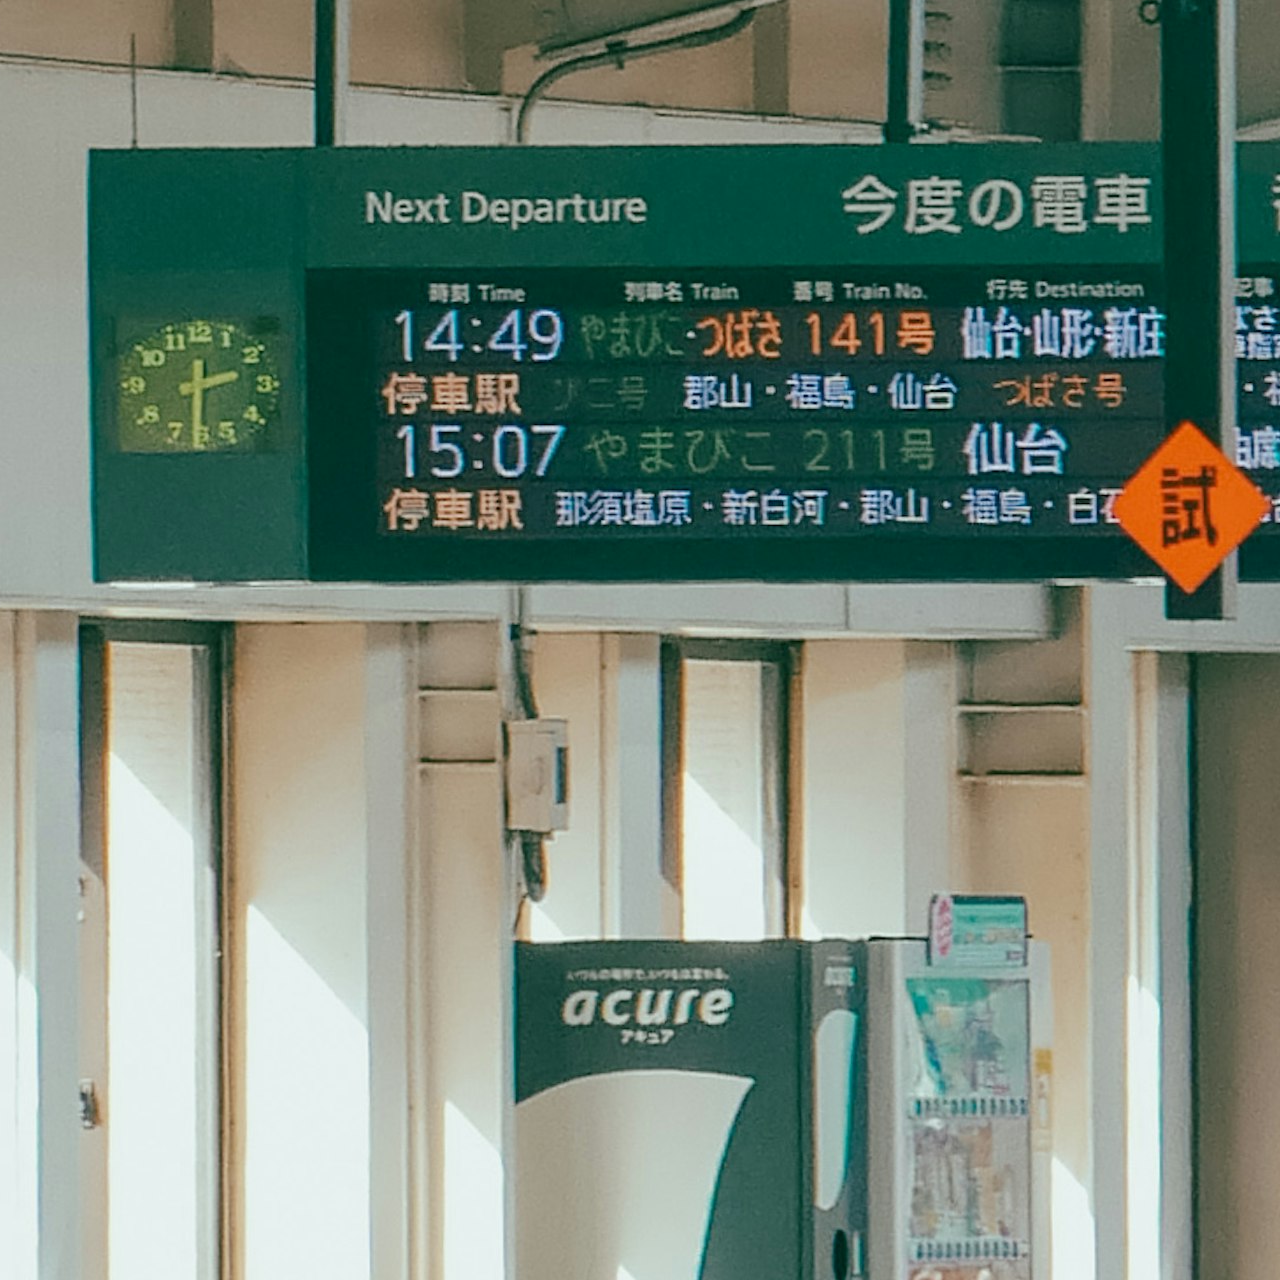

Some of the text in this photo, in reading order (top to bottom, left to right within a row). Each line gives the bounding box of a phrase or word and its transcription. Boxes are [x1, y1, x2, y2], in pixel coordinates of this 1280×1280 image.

[365, 191, 648, 230] Next Departure
[841, 173, 1153, 235] 今度の電車
[478, 283, 527, 302] Time
[624, 282, 740, 303] 列車名 Train
[843, 281, 892, 301] Train
[895, 282, 928, 301] No.
[986, 278, 1145, 300] 行先 Destination
[165, 333, 186, 351] 11
[187, 324, 213, 343] 12
[394, 308, 566, 362] 14:49
[804, 310, 936, 356] 141号
[141, 349, 166, 367] 10
[242, 346, 261, 364] 2
[129, 375, 147, 395] 9
[256, 374, 273, 393] 3
[381, 371, 522, 416] 停車駅
[993, 372, 1128, 408] つばさ号
[143, 404, 161, 423] 8
[242, 404, 260, 422] 4
[167, 421, 184, 439] 7
[219, 421, 236, 439] 5
[396, 424, 567, 478] 15:07
[585, 426, 776, 476] やまびこ
[803, 428, 936, 472] 211号
[963, 421, 1068, 476] 仙台
[383, 487, 524, 531] 停車駅
[561, 987, 734, 1026] acure
[620, 1029, 675, 1045] アキュア
